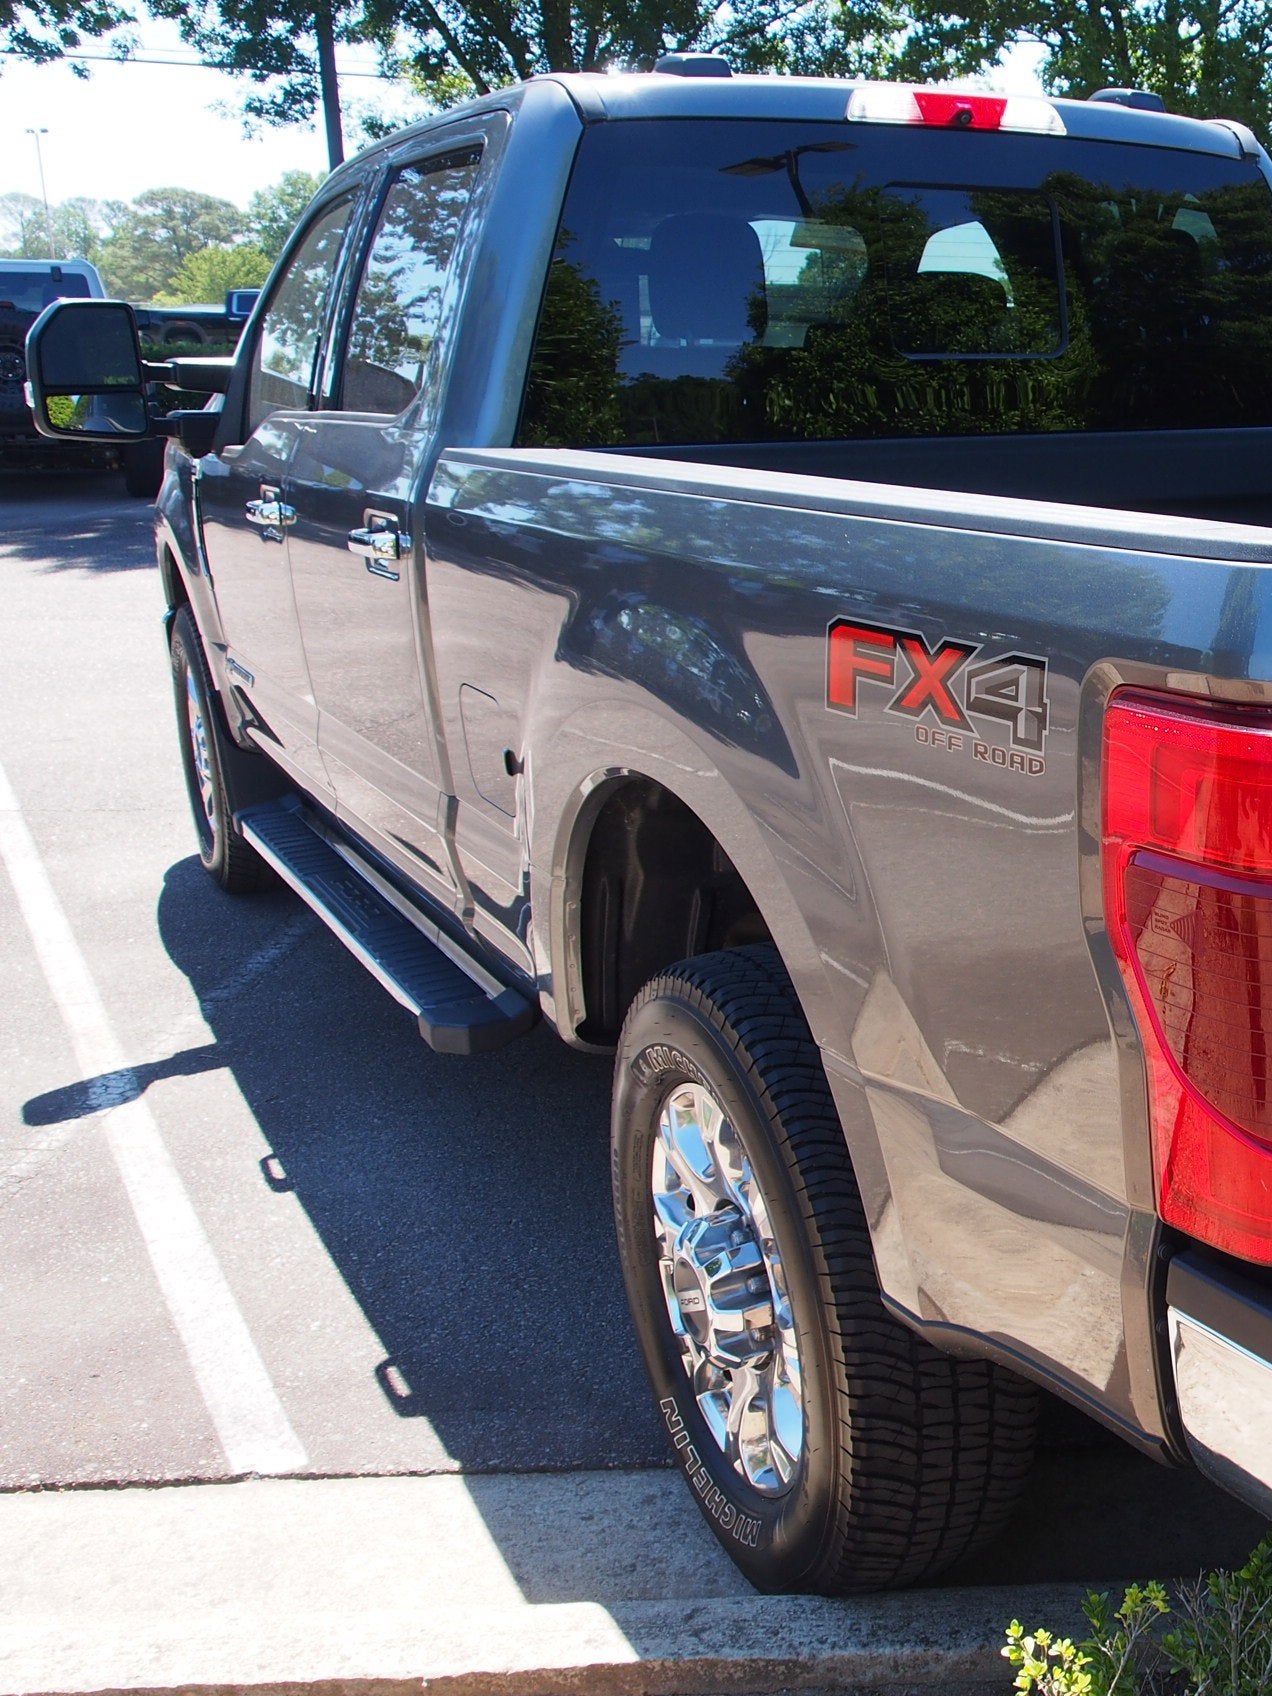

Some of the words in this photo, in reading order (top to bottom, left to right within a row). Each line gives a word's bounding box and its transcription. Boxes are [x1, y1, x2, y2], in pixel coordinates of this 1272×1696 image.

[825, 614, 1050, 756] FX4
[914, 723, 964, 753] OFF
[972, 740, 1046, 777] ROAD
[659, 1396, 763, 1548] MICHELIN
